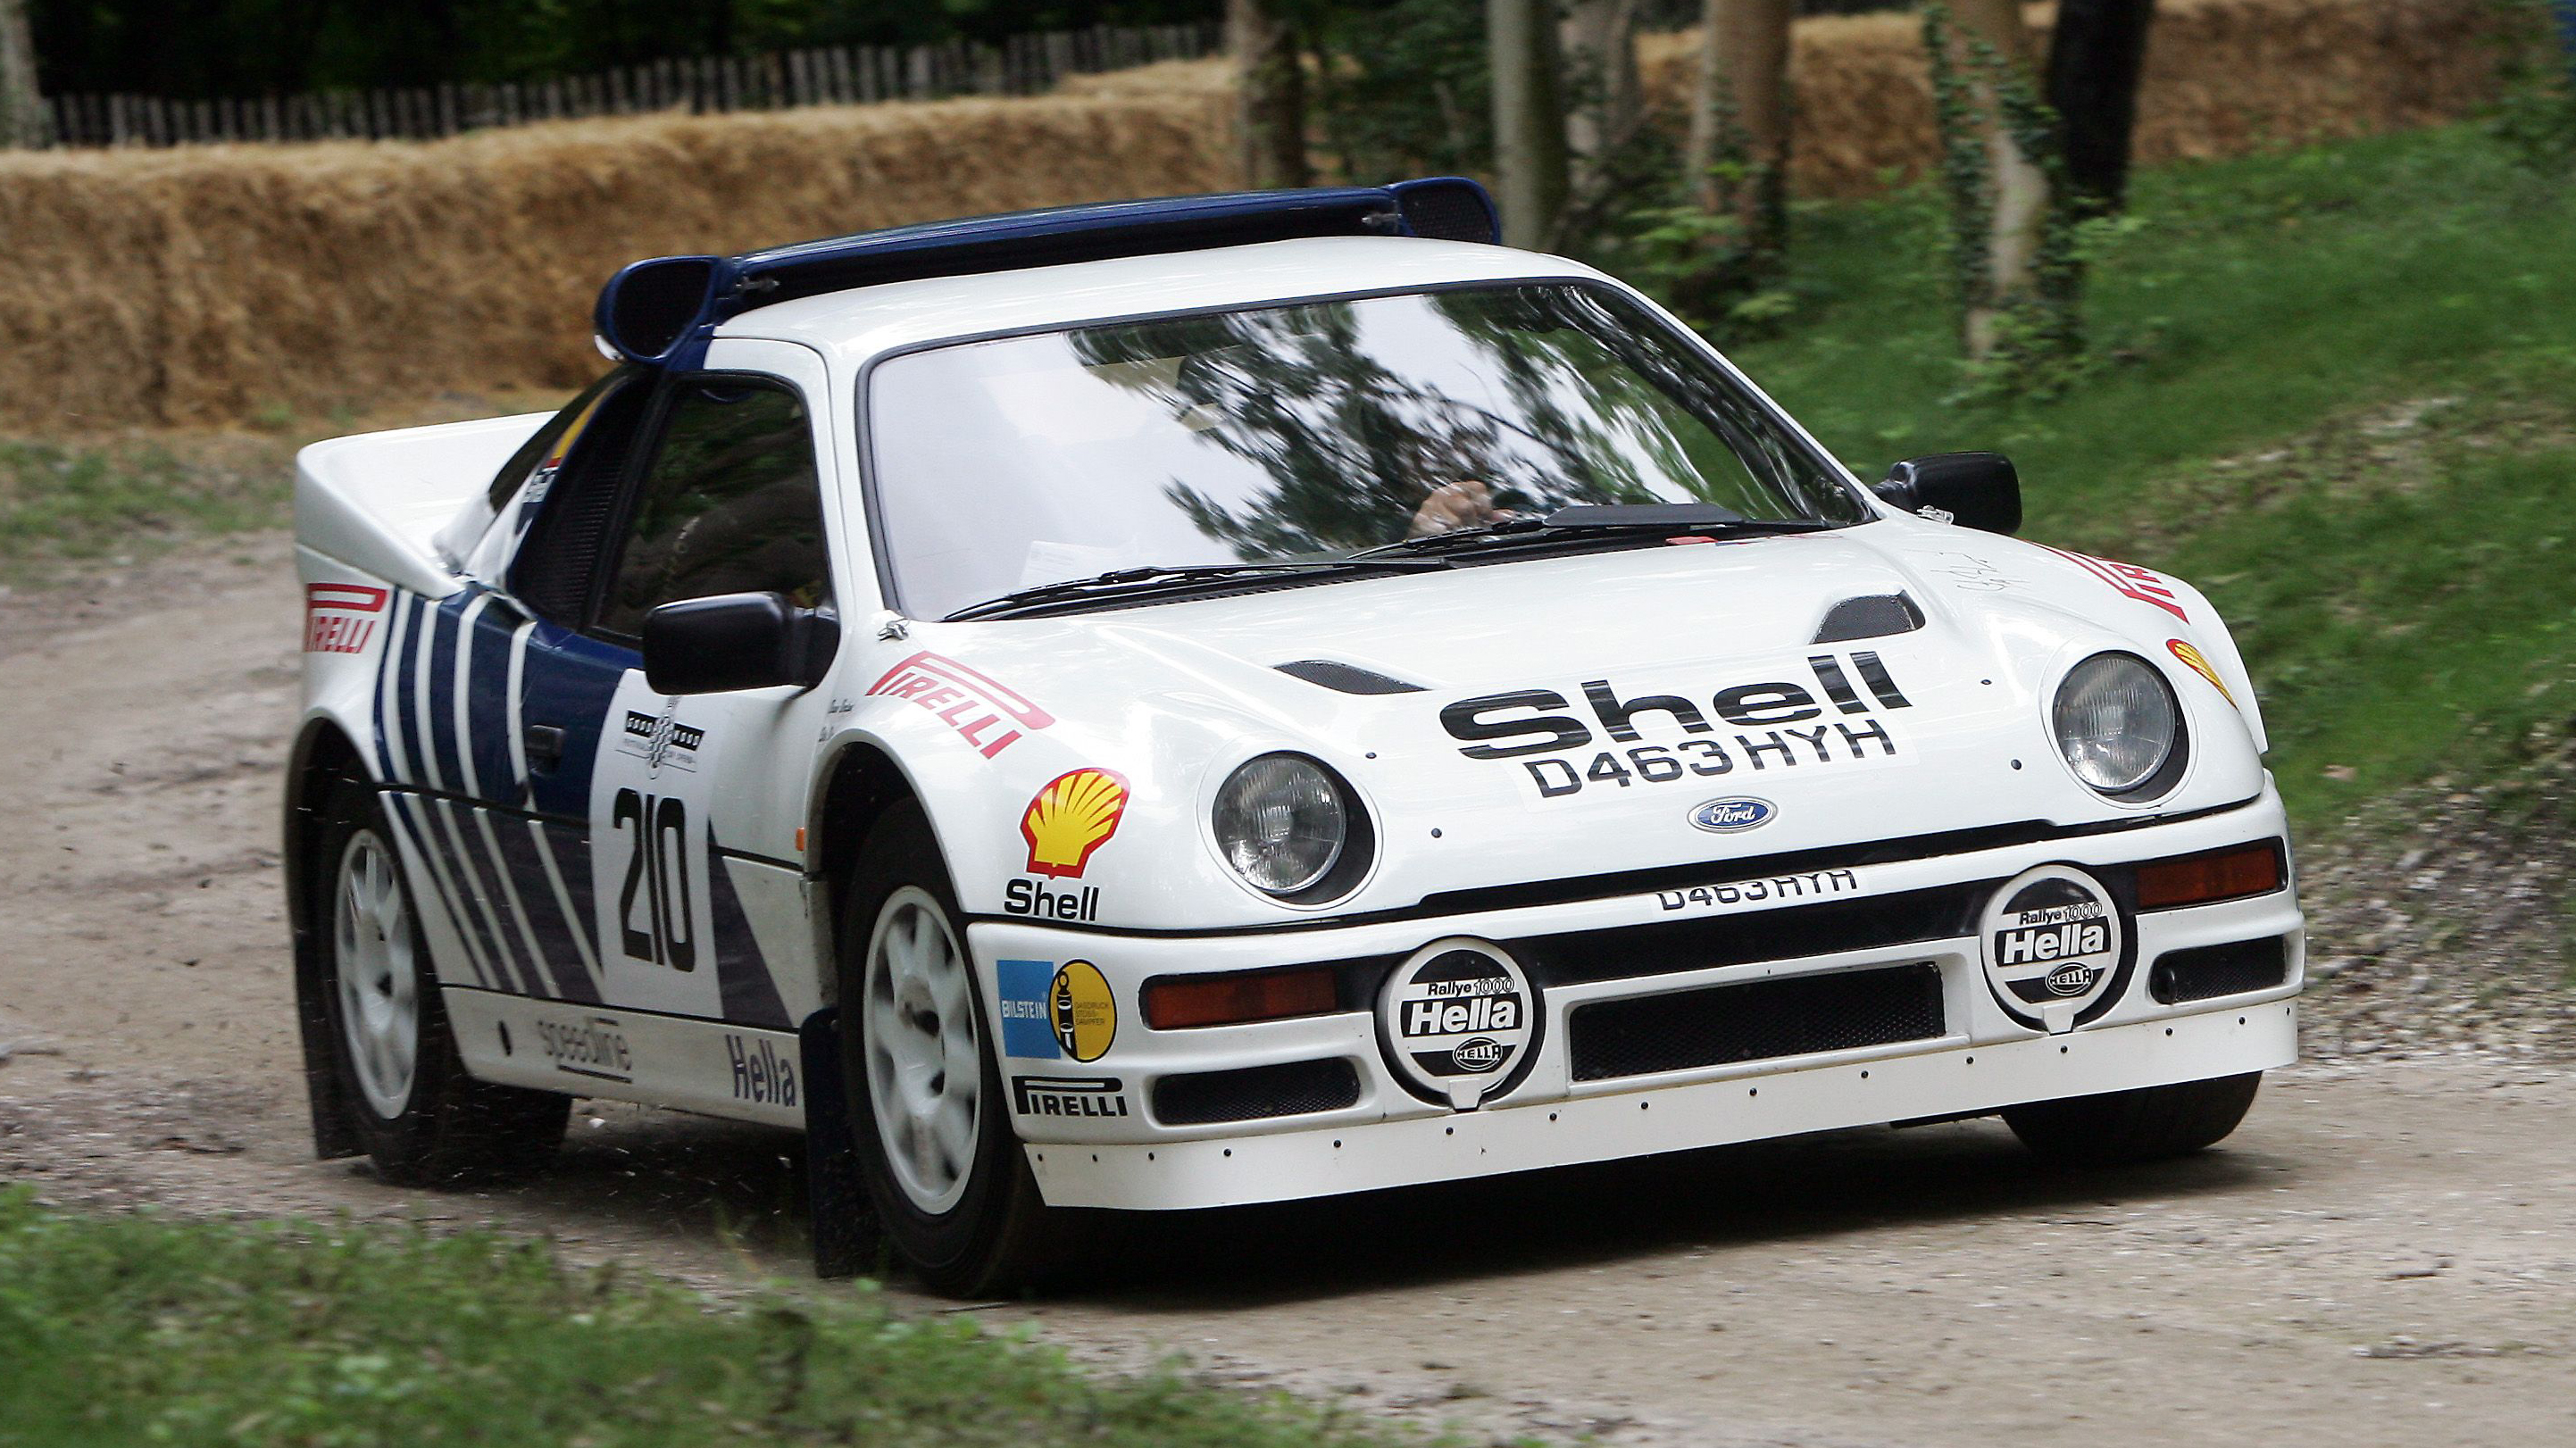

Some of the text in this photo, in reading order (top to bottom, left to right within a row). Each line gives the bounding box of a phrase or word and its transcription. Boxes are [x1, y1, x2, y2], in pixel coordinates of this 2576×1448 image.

[864, 650, 1055, 760] PIRELLI
[1439, 651, 1913, 760] Shell
[1711, 803, 1755, 823] Ford
[612, 786, 695, 973] 210
[1005, 879, 1099, 921] Shell
[2020, 902, 2103, 926] Rallye 1000
[2004, 923, 2105, 964] Hella
[1429, 977, 1515, 997] Rallye 1000
[2050, 969, 2092, 986] HELLA
[1001, 1000, 1047, 1019] BILSTEIN
[1409, 997, 1516, 1035] Hella
[538, 1017, 633, 1082] speedline
[1457, 1044, 1502, 1061] HELLA
[725, 1034, 796, 1108] Hella
[1012, 1076, 1129, 1117] PIRELLI
